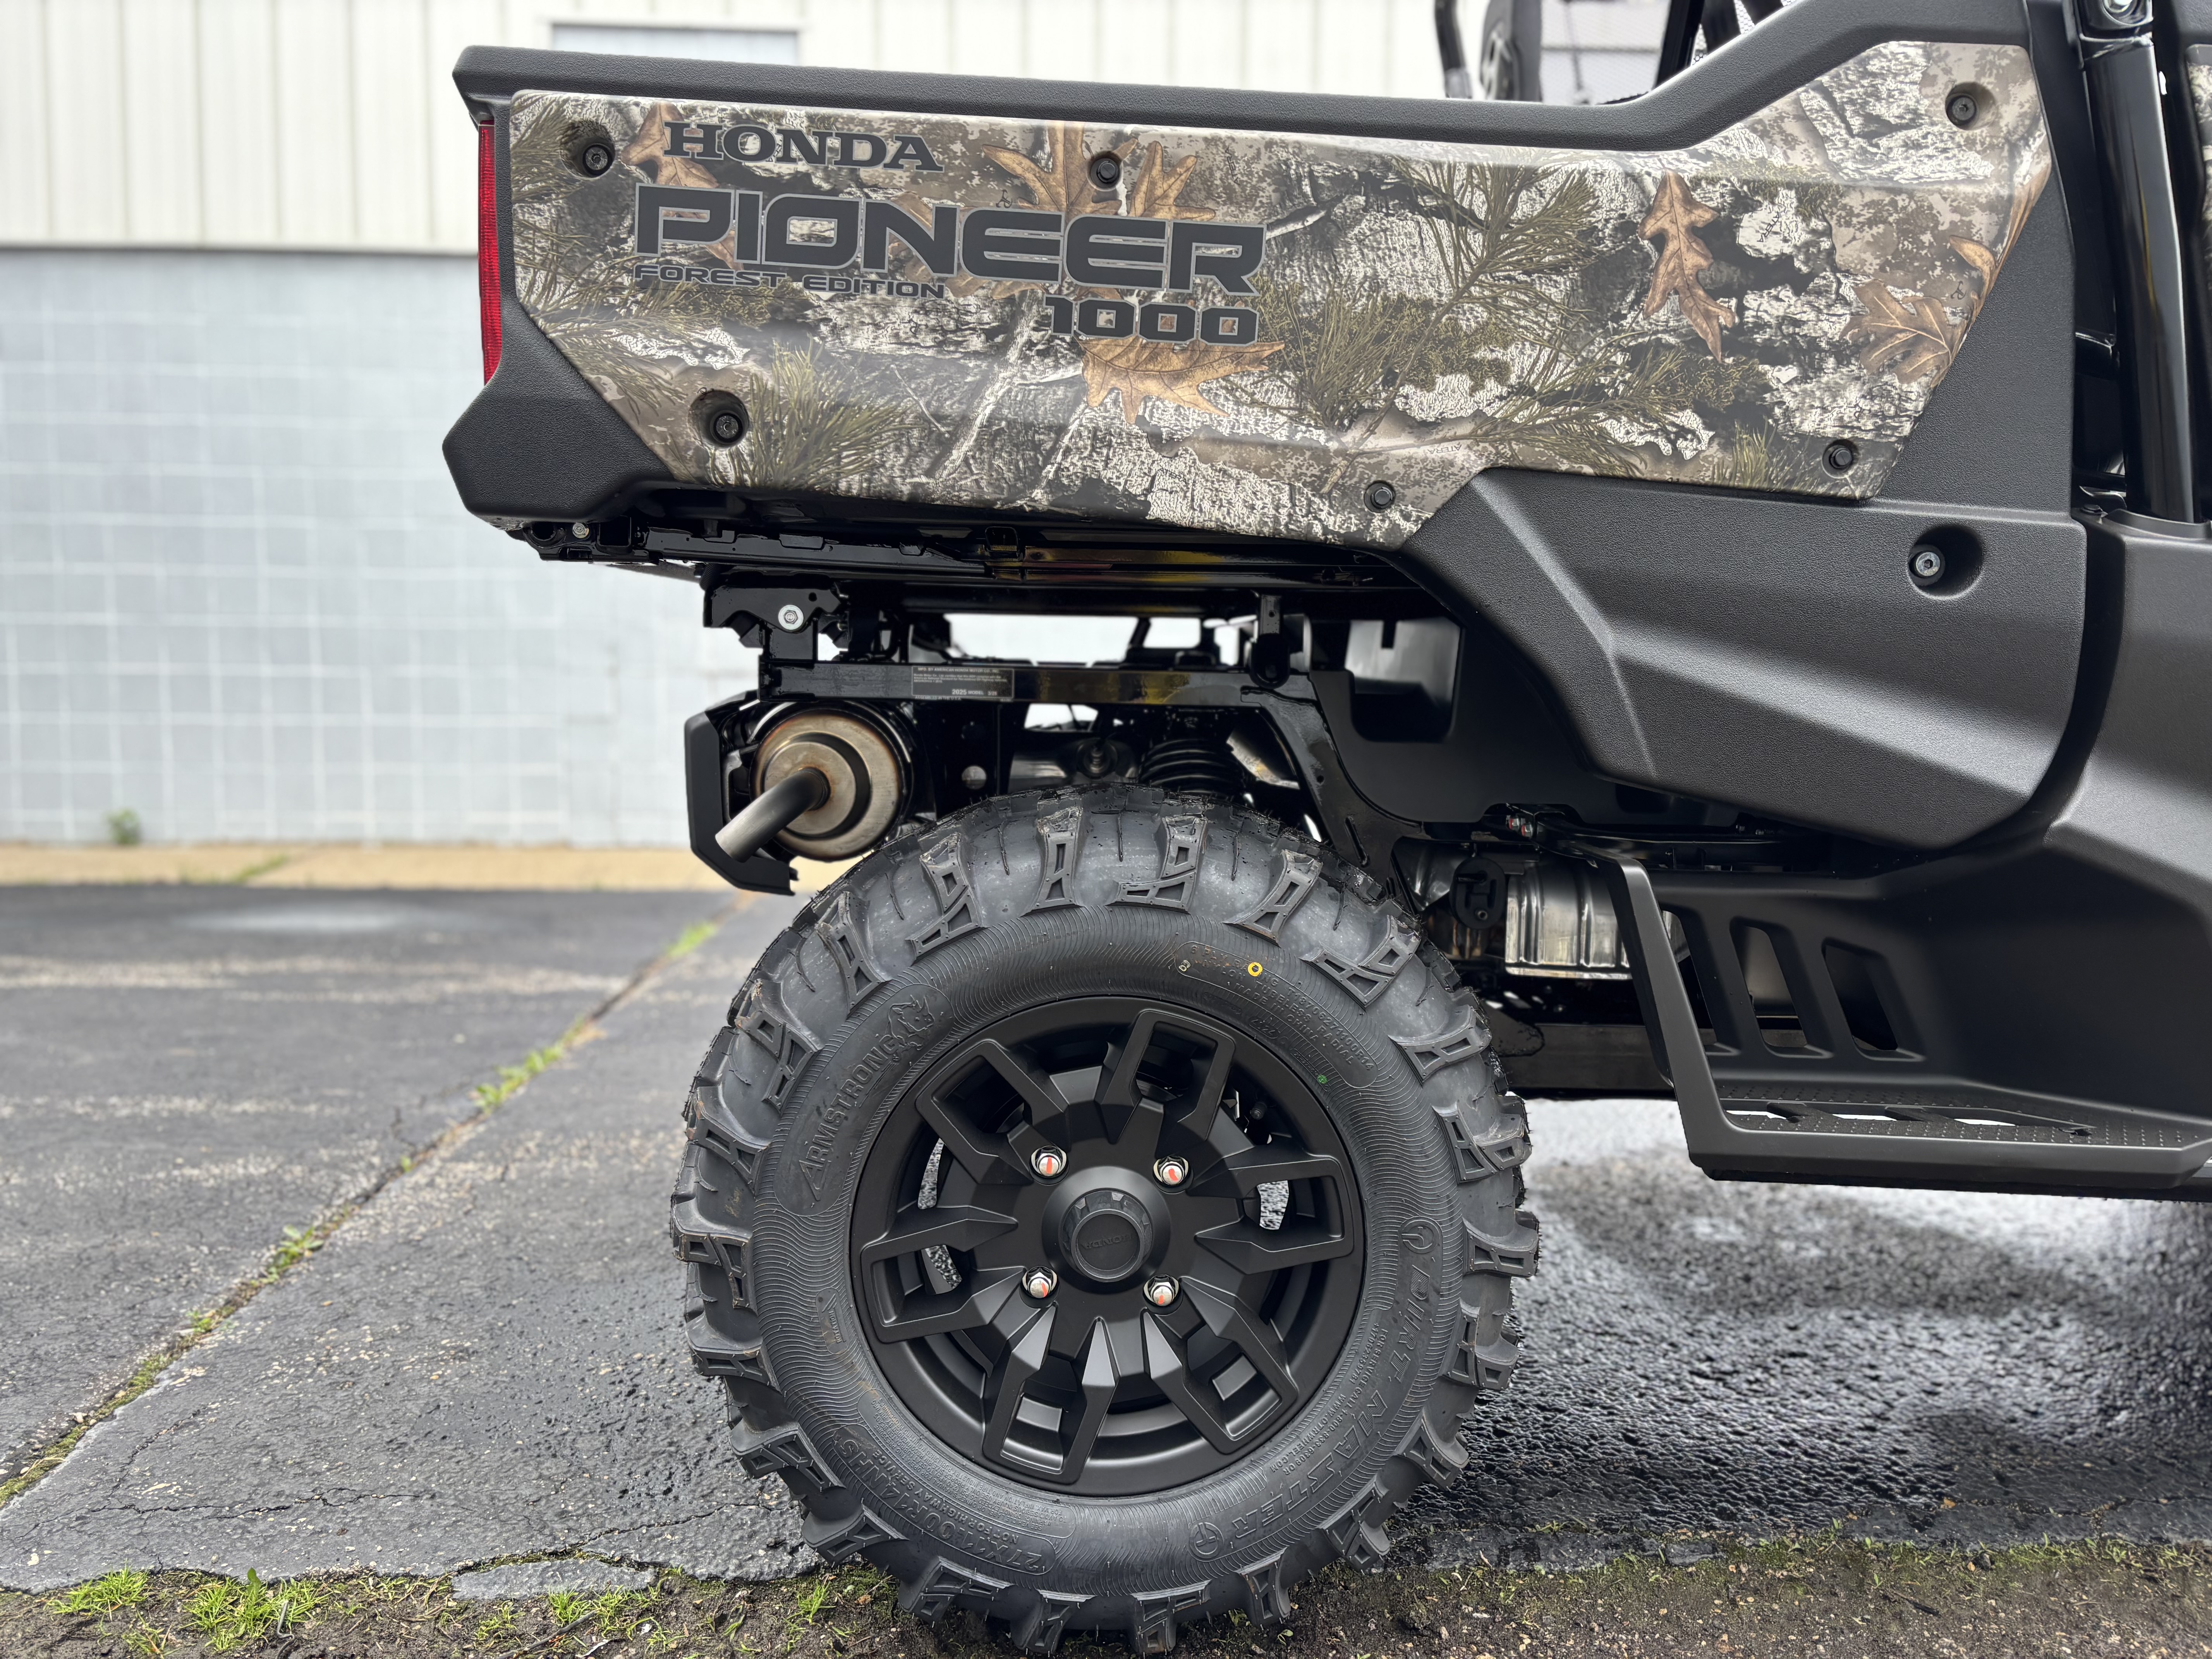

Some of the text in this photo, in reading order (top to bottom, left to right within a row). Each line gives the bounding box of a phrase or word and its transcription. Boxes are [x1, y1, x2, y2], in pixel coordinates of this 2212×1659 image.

[663, 121, 945, 172] HONDA
[1225, 146, 1240, 185] ATERA
[1757, 211, 1779, 242] ATERA
[635, 183, 1266, 297] PIONEER
[634, 264, 944, 299] FOREST EDITION
[1044, 296, 1260, 346] 1000
[1427, 444, 1462, 454] ATERA
[1158, 467, 1187, 486] ATERA
[1190, 944, 1199, 954] 6
[1202, 947, 1228, 963] PLY
[1231, 958, 1280, 988] RAING
[1285, 987, 1375, 1071] T18706271100R14
[1201, 959, 1245, 981] NYLON
[1252, 980, 1313, 1023] TUBELESS
[1316, 1024, 1355, 1065] RADIAL
[1233, 982, 1269, 1005] MADE
[1270, 1002, 1284, 1015] IN
[1285, 1013, 1319, 1042] CHINA
[799, 1033, 902, 1201] ARMSTRONG
[828, 1310, 843, 1344] ROTATION
[1375, 1328, 1389, 1348] FOR
[1357, 1348, 1382, 1389] SERVICE
[1230, 1265, 1431, 1539] DIRT MASTER
[1344, 1386, 1363, 1410] CALL
[872, 1413, 888, 1431] BEADS
[886, 1419, 894, 1428] BY
[1269, 1393, 1346, 1474] WWW.OTRWHEEL.COM
[874, 1424, 897, 1450] PRESSURE
[886, 1429, 915, 1458] LUBRICATED
[891, 1426, 925, 1459] RECOMMENDED
[903, 1428, 927, 1452] MOUNTING
[895, 1448, 922, 1473] OPERATING
[912, 1456, 927, 1469] SEAT
[925, 1449, 953, 1472] PUBLISHED
[926, 1466, 934, 1475] TO
[1282, 1463, 1296, 1476] OR
[920, 1470, 932, 1481] FOR
[931, 1478, 953, 1495] MANUAL
[945, 1472, 966, 1488] PROPER
[952, 1469, 979, 1488] INDUSTRY
[872, 1448, 1018, 1544] NOT FOR HIGHWAY SERVICE
[959, 1489, 969, 1498] PSI
[978, 1498, 1000, 1511] EXCEED
[981, 1492, 992, 1502] USE
[992, 1491, 1004, 1499] AND
[993, 1498, 1013, 1510] INJURY
[1004, 1495, 1034, 1510] INFLATION
[986, 1509, 1004, 1520] LABEL
[1013, 1506, 1038, 1518] SERIOUS
